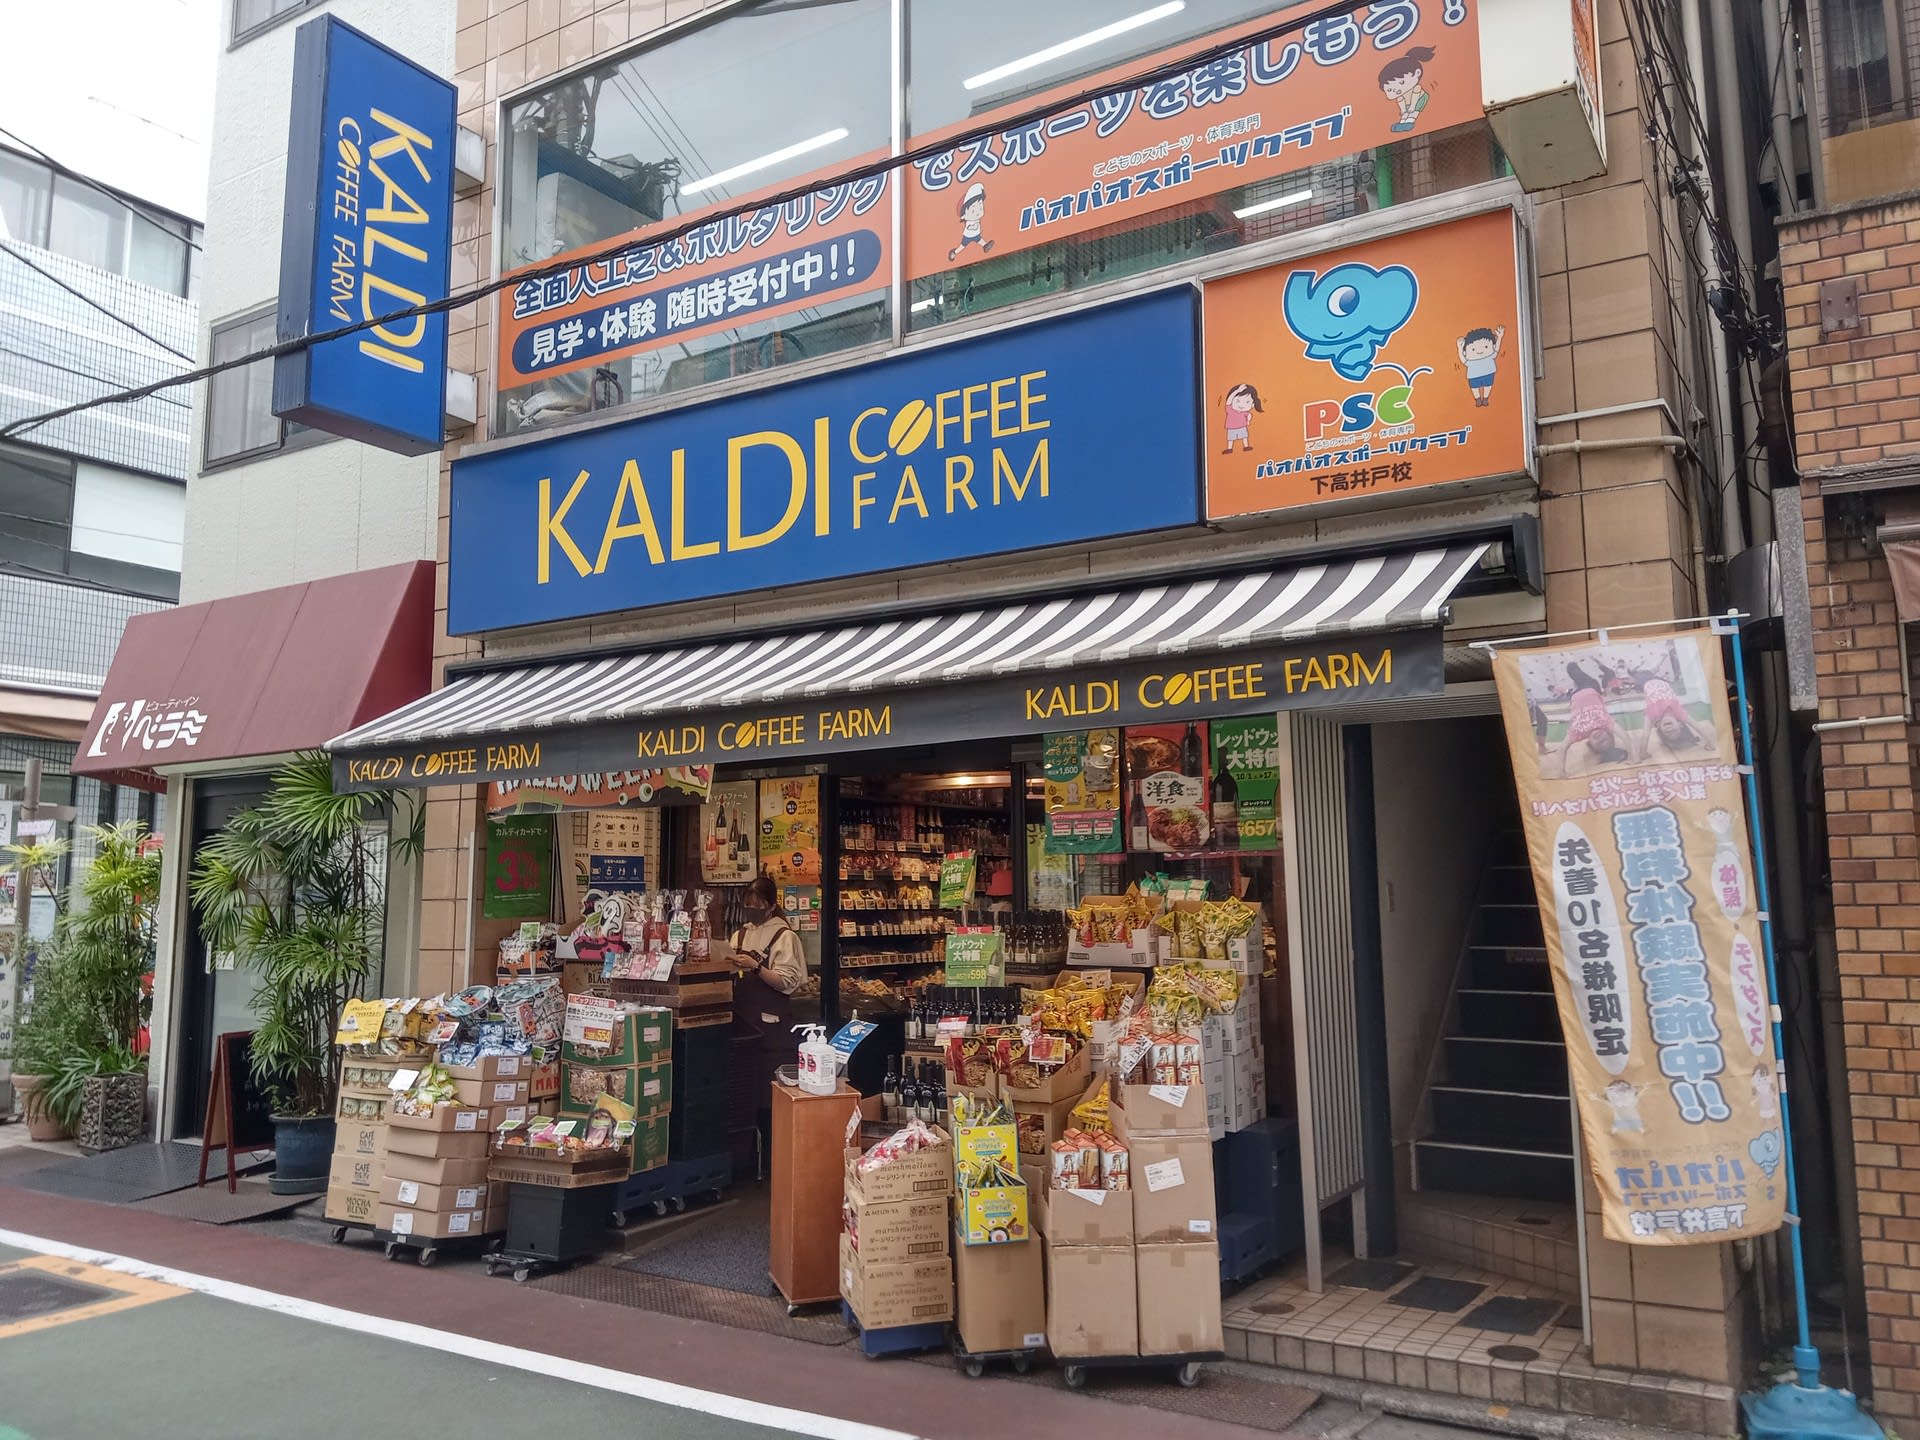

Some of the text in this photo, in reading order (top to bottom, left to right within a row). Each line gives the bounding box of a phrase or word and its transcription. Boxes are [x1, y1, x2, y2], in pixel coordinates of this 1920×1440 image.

[1019, 106, 1352, 231] パオパオスポーツクラブ
[329, 116, 362, 322] COFFEE FARM
[359, 107, 433, 374] KALDI
[529, 301, 656, 369] 見学・体験
[848, 370, 1051, 464] COFFEE
[1303, 385, 1415, 442] PSC
[1256, 426, 1473, 480] パオパオスポーツクラブ
[1310, 462, 1413, 495] 下高井戸校
[537, 416, 831, 585] KALDI
[852, 438, 1051, 530] FARM
[1025, 649, 1393, 720] KALDI COFFEE FARM
[637, 705, 892, 759] KALDI COFFEE FARM
[349, 742, 541, 784] KALDI COFFEE FARM
[1146, 780, 1186, 797] 洋食
[1156, 797, 1177, 805] ワイン
[949, 938, 986, 951] レッドウッド
[953, 950, 981, 961] 大特価
